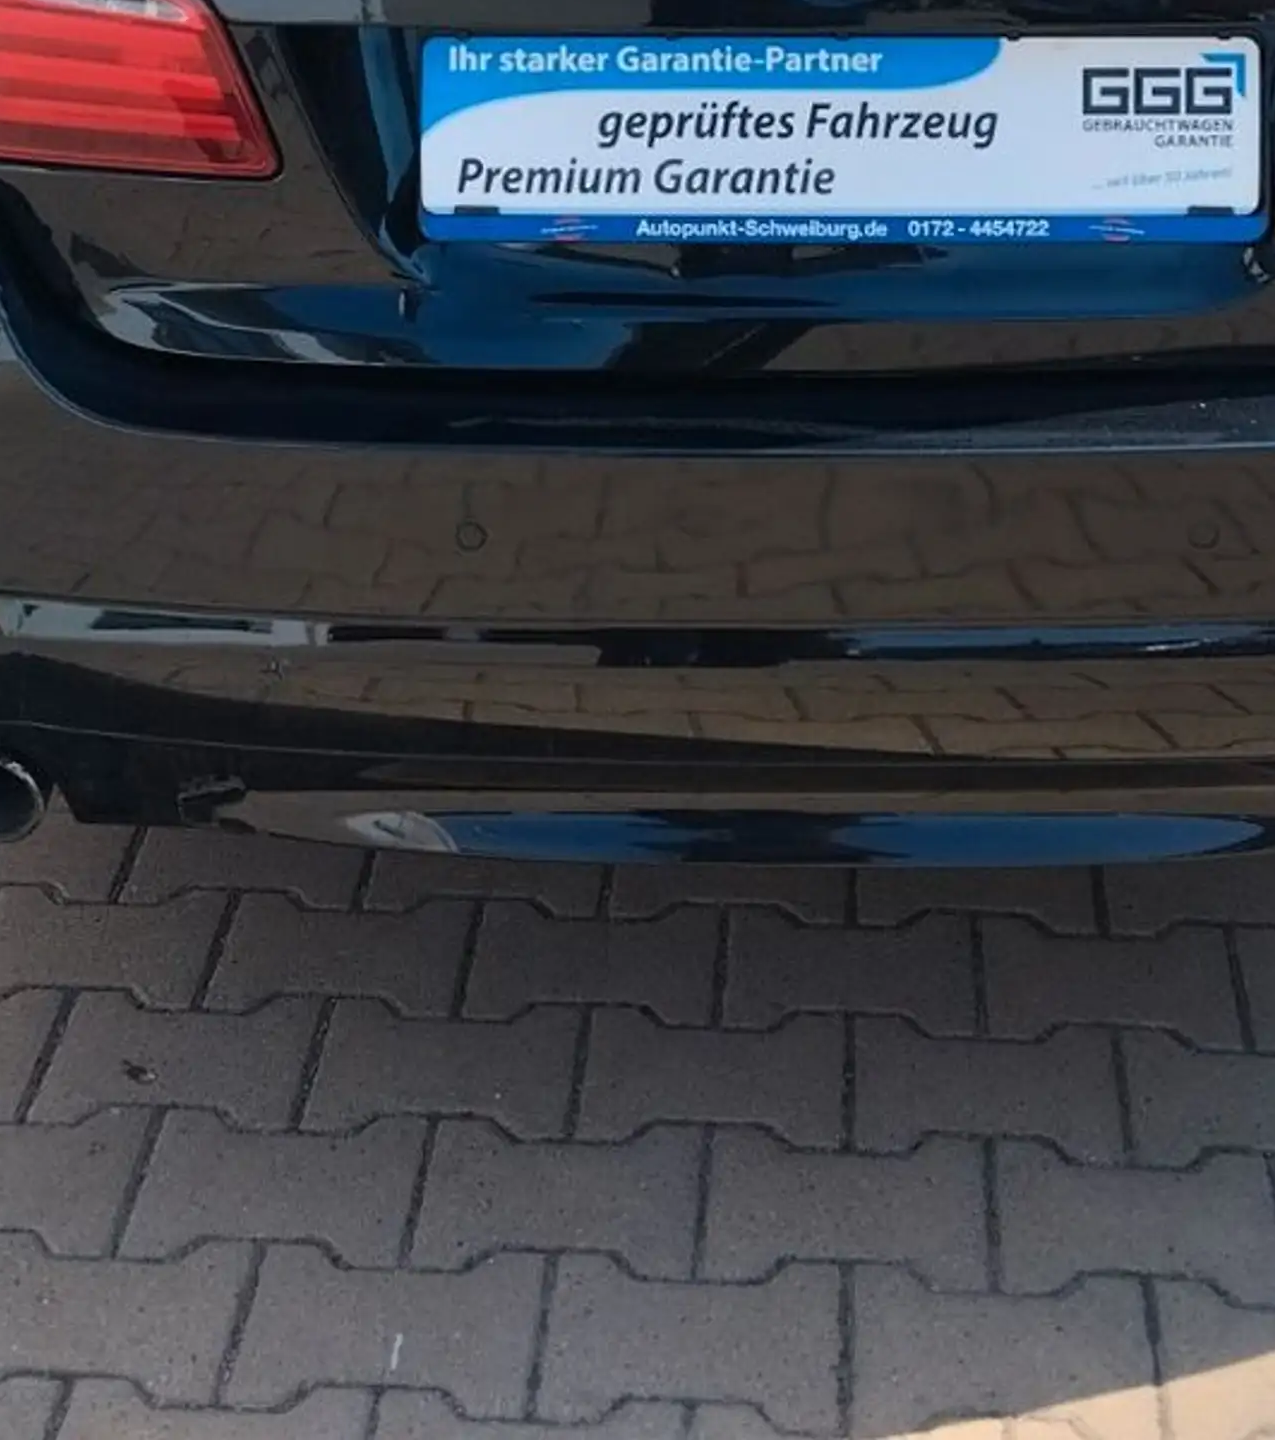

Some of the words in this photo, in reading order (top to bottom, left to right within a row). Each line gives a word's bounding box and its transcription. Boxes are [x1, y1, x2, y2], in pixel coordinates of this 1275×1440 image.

[448, 44, 488, 72] Ihr
[499, 44, 608, 72] starker
[617, 44, 884, 73] Garantie-Partner
[1082, 67, 1233, 115] GGG
[597, 100, 795, 148] geprüftes
[806, 101, 999, 149] Fahrzeug
[1082, 118, 1234, 132] GEBRAUCHTWAGEN
[1153, 134, 1234, 148] GARANTIE
[456, 156, 642, 195] Premium
[653, 156, 836, 195] Garantie
[635, 218, 888, 240] Autopunkt-Schweiburg.de
[906, 219, 955, 237] 0172
[968, 219, 1051, 237] 4454722
